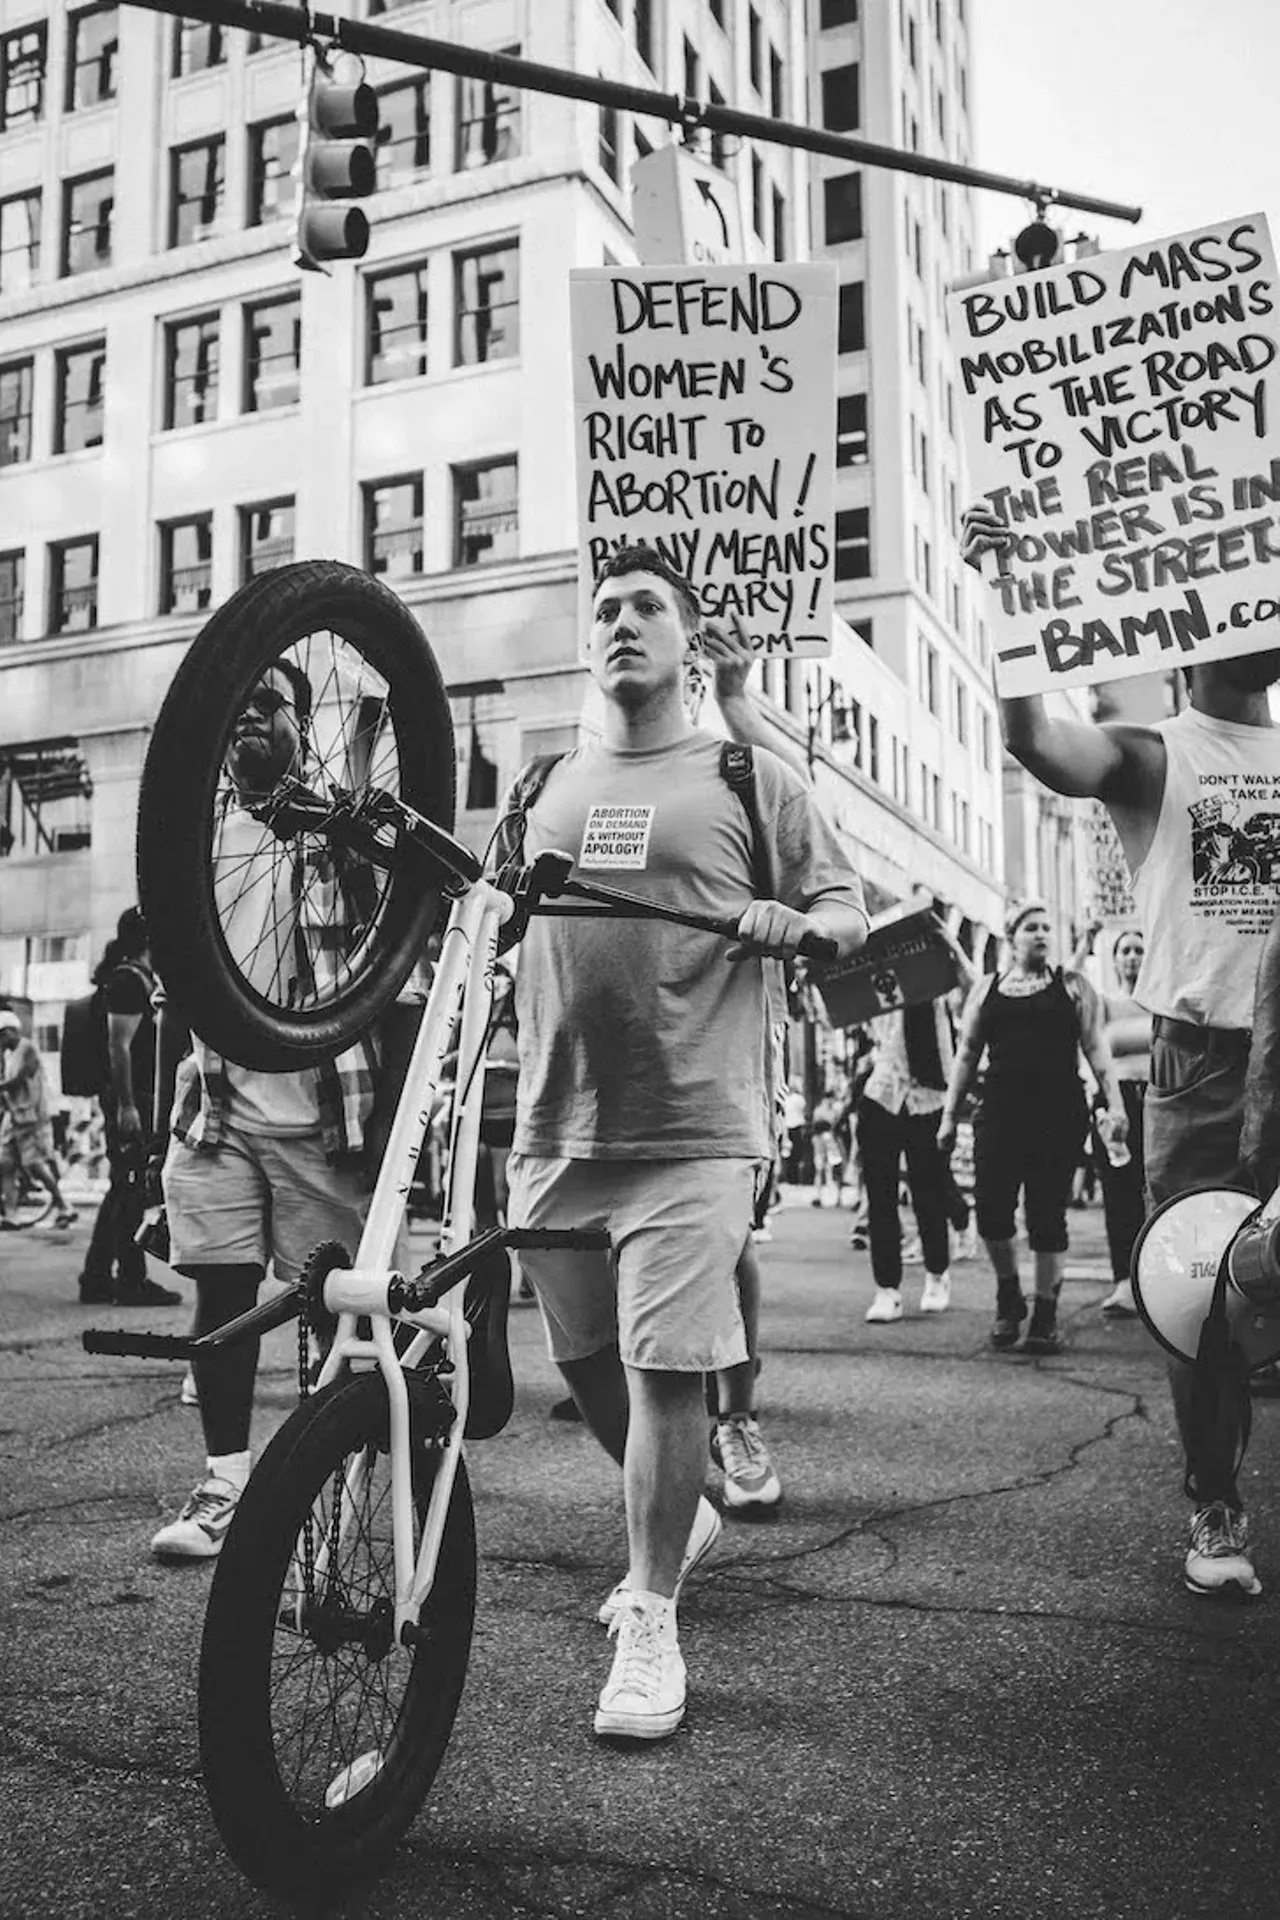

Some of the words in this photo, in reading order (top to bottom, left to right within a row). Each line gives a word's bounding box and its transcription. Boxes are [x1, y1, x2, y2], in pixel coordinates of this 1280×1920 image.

[611, 272, 802, 334] DEFEND
[961, 270, 1107, 337] BUILD
[1119, 225, 1262, 299] MASS
[960, 280, 1273, 394] MOBILIZATIONS
[588, 343, 794, 400] WOMEN'S
[984, 393, 1043, 443] AS
[1050, 365, 1137, 417] THE
[1141, 334, 1276, 396] ROAD
[584, 411, 707, 461] RIGHT
[725, 418, 766, 454] TO
[1003, 438, 1062, 478] TO
[1080, 378, 1266, 458] VICTORY
[984, 476, 1063, 527] THE
[1084, 443, 1219, 506] REAL
[994, 504, 1166, 576] POWER
[1171, 485, 1225, 525] IS
[1232, 457, 1280, 511] IN
[636, 528, 700, 582] NY
[704, 523, 829, 579] MEANS
[989, 565, 1083, 616] THE
[1199, 774, 1239, 785] DON'T
[1229, 788, 1269, 800] TAKE
[587, 832, 595, 841] &
[598, 832, 645, 841] WITHOUT
[589, 820, 603, 829] ON
[605, 820, 648, 829] DEMAND
[592, 808, 650, 818] ABORTION
[584, 843, 644, 855] APOLOGY!
[1193, 885, 1229, 898] STOP
[1203, 909, 1216, 917] BY
[1219, 908, 1239, 917] ANY
[1241, 908, 1275, 917] MEANS
